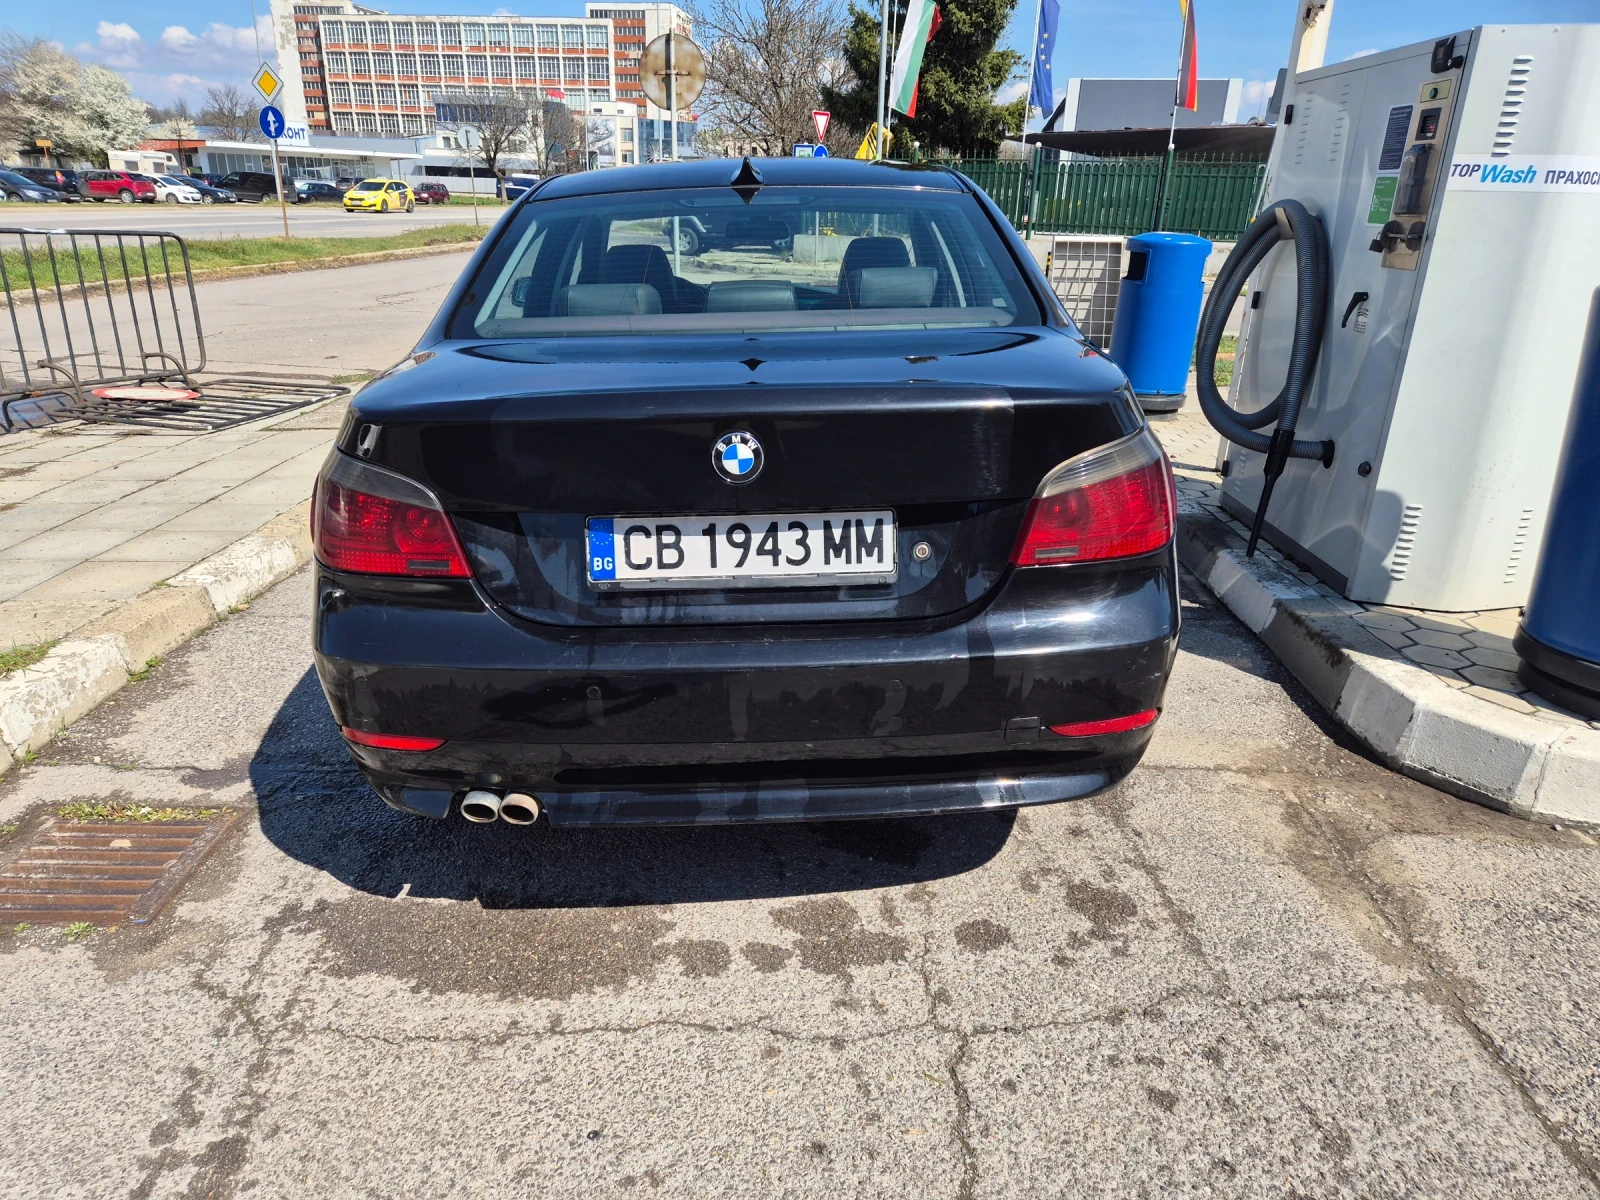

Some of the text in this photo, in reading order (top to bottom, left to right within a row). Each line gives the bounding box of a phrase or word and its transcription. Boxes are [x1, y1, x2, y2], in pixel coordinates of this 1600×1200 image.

[1543, 169, 1600, 186] ПРАХОС
[716, 434, 758, 452] BMW
[623, 518, 884, 570] CB 1943 MM
[593, 556, 613, 571] BG
